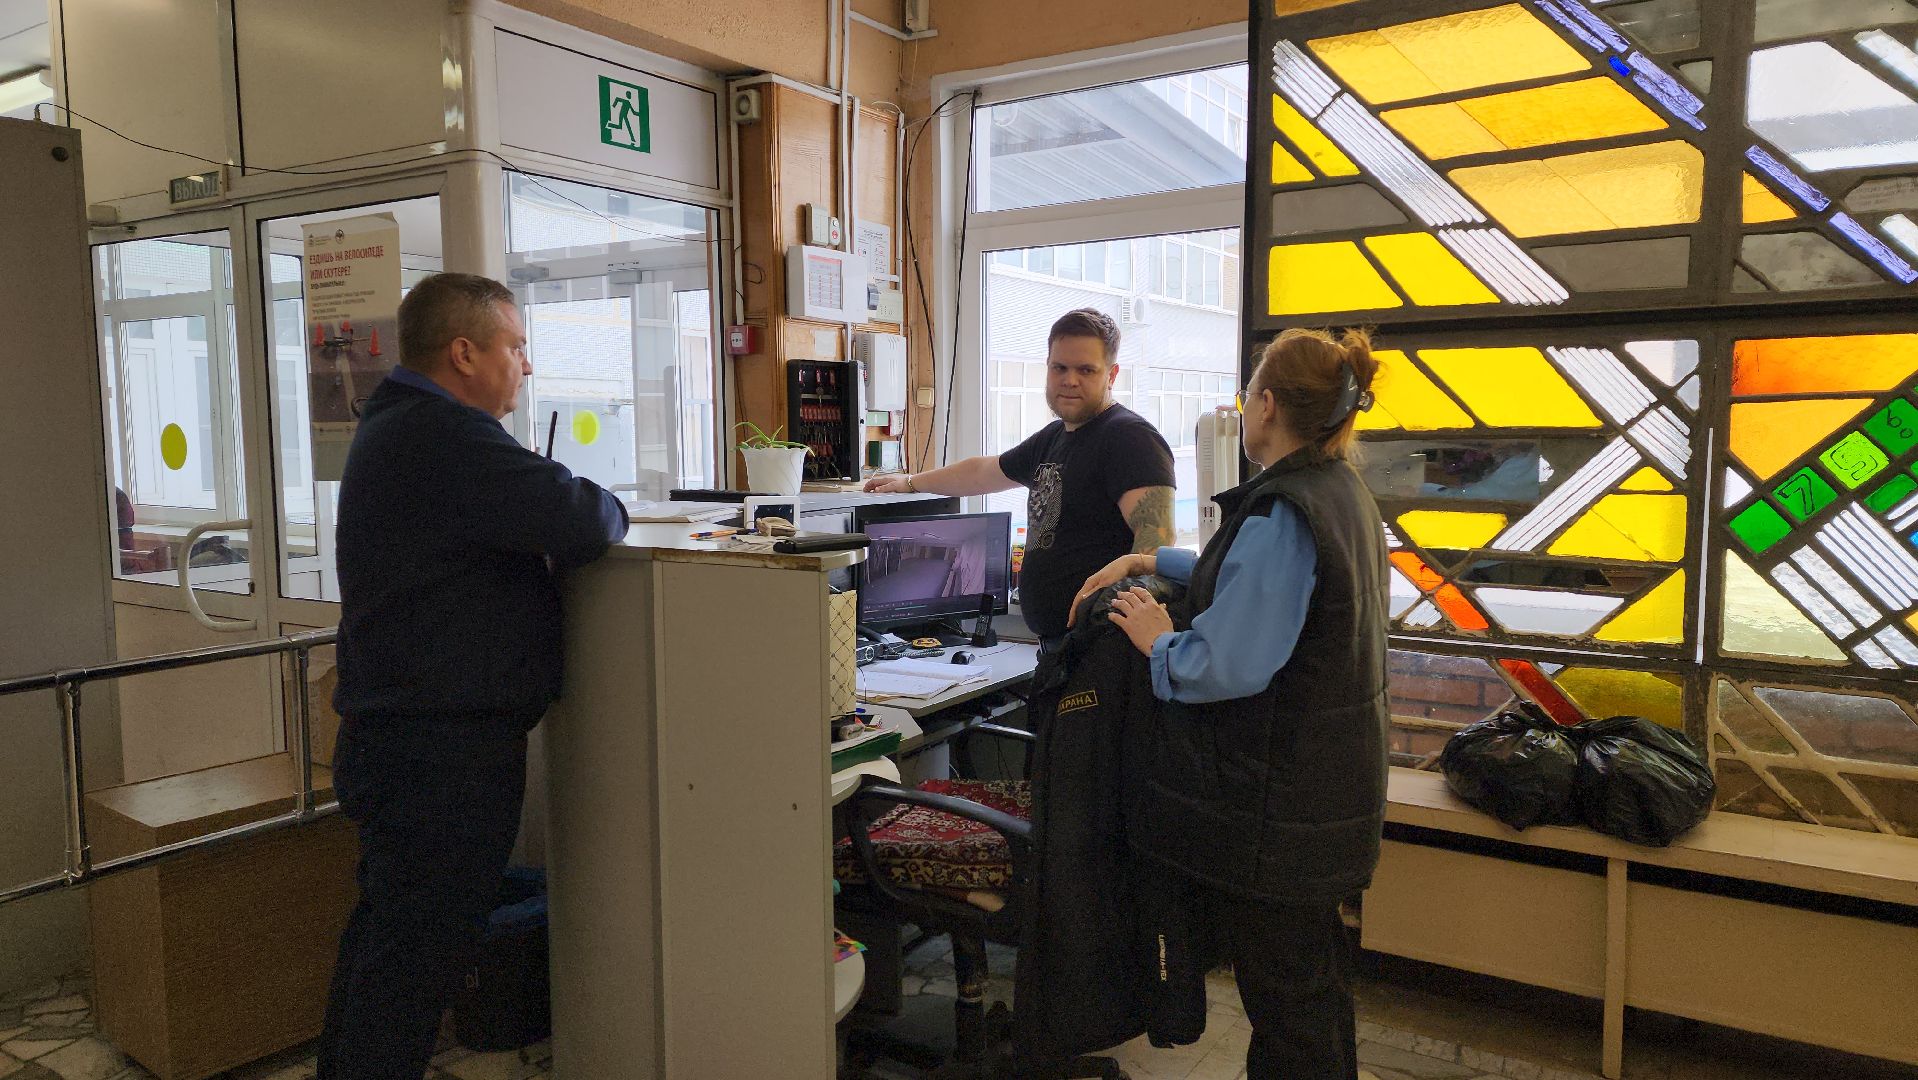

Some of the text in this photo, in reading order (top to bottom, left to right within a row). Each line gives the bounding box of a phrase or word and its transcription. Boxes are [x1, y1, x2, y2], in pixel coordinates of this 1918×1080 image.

[174, 176, 219, 201] ВЫХОД
[309, 245, 385, 265] ЕЗДИШЬ НА ВЕЛОСИПЕДЕ
[310, 265, 351, 281] ИЛИ СКУТЕРЕ?
[1057, 694, 1093, 712] РАНА
